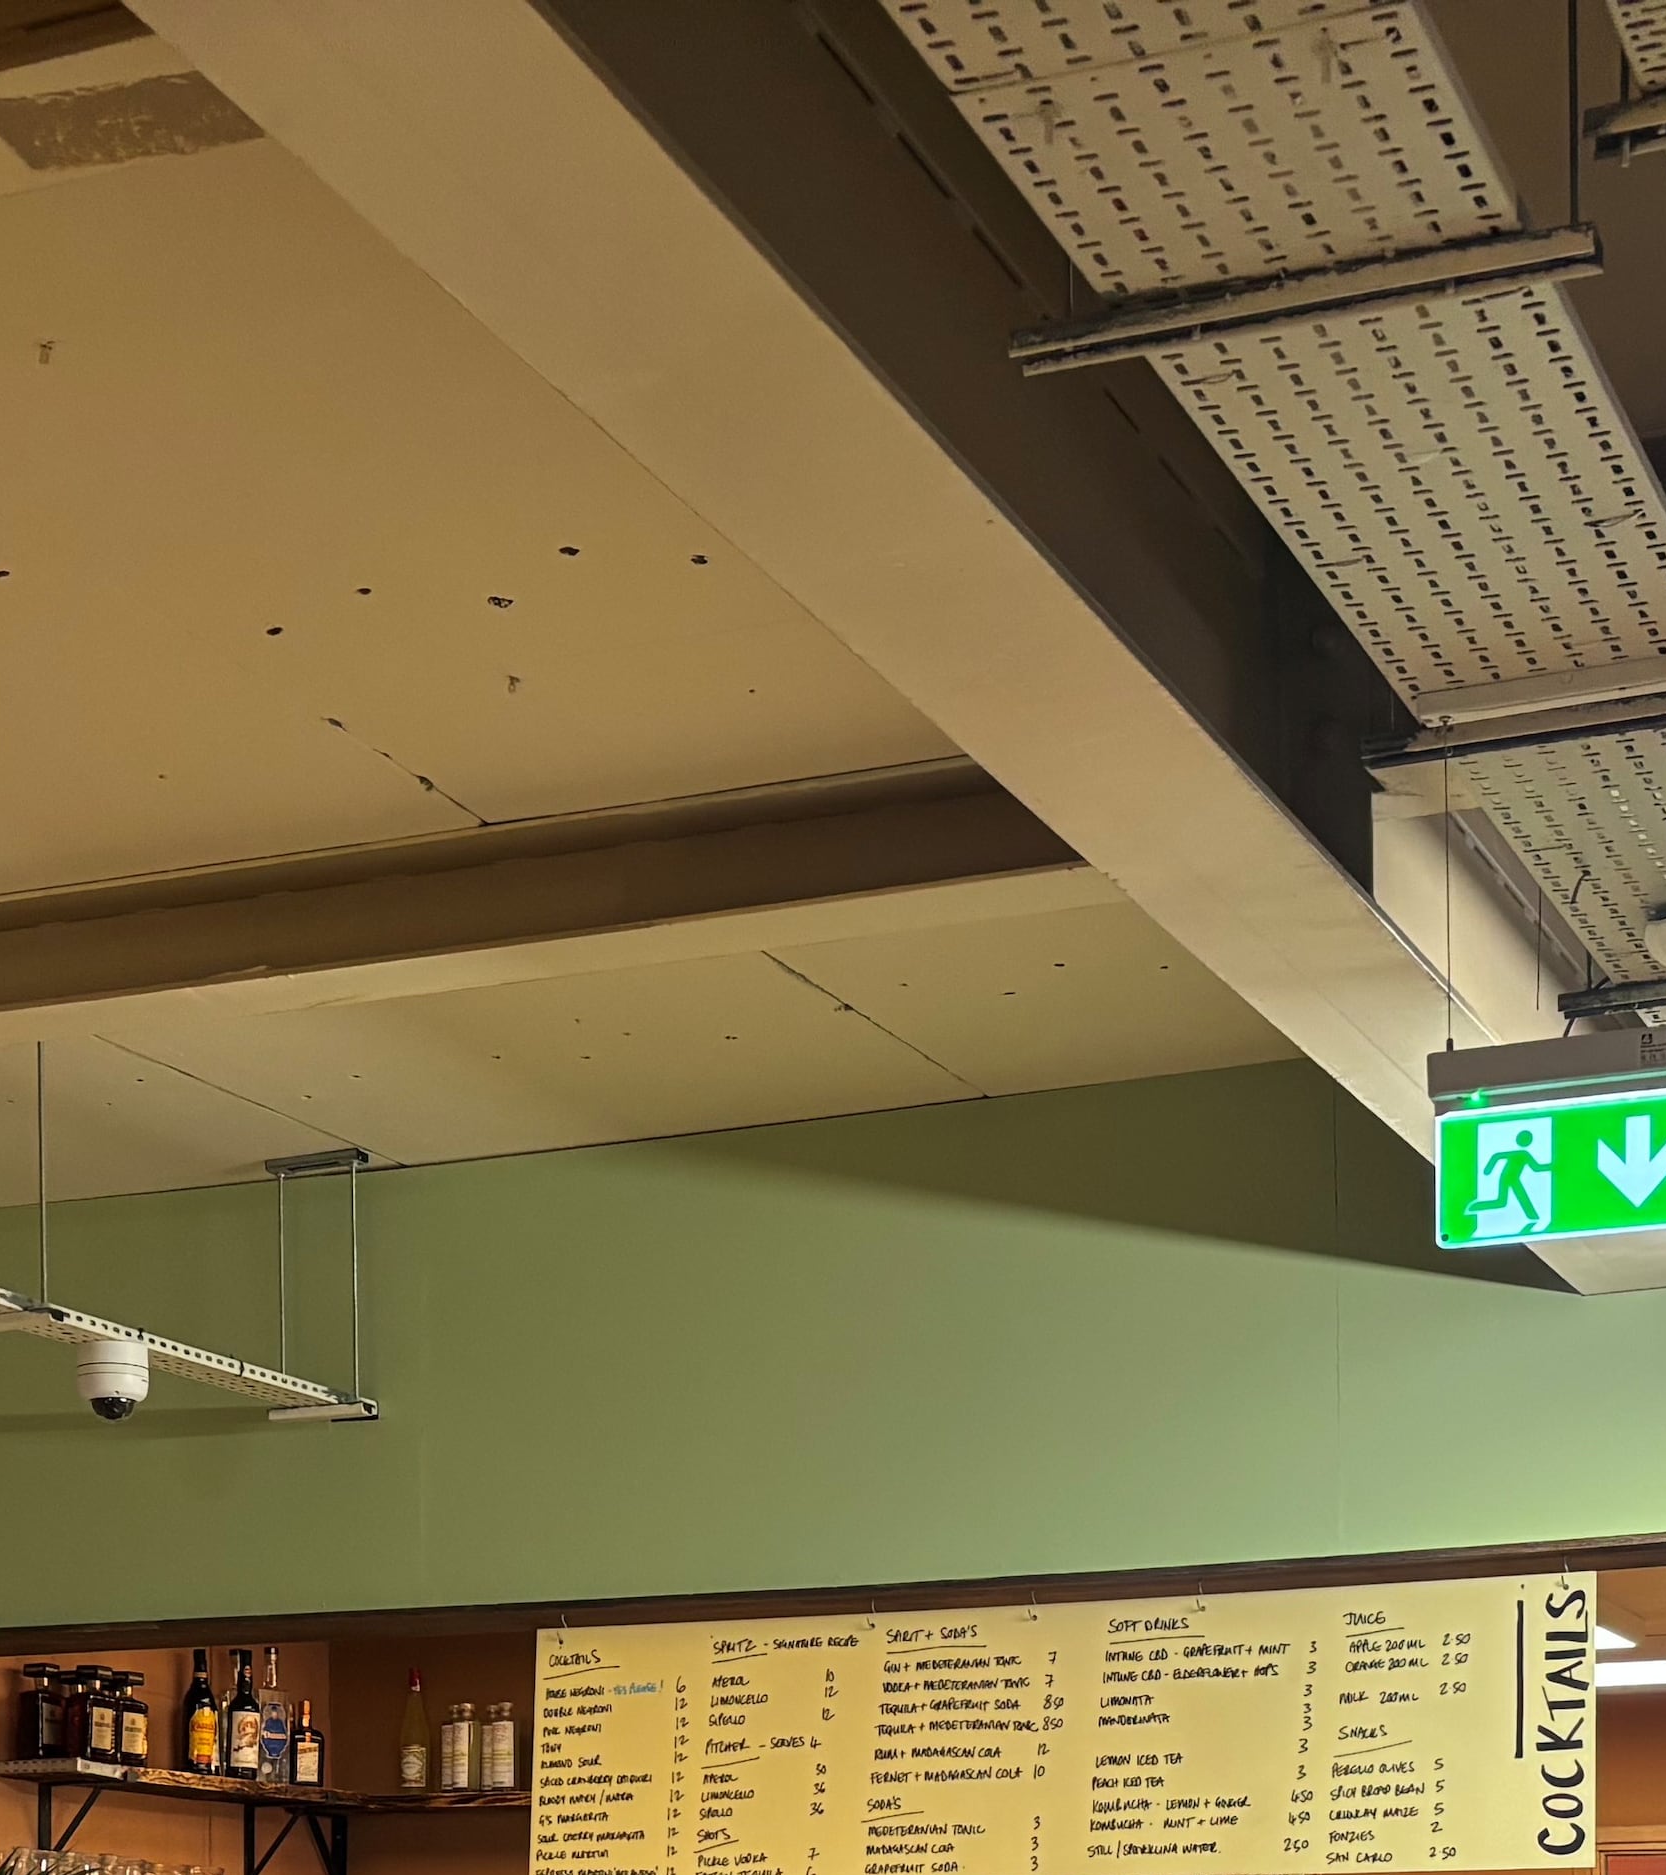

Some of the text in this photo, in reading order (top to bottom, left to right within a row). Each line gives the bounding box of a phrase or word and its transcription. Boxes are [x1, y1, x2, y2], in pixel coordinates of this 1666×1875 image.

[1107, 1617, 1189, 1633] SOFT DRINKS
[1343, 1611, 1386, 1626] JUICE
[940, 1625, 977, 1639] SODA'S
[713, 1635, 859, 1655] SPRITZ SIGNATURE RECIPE
[1149, 1648, 1168, 1661] CBD
[1259, 1643, 1291, 1656] MINT
[1309, 1641, 1317, 1653] 3
[1349, 1639, 1382, 1653] APPLE
[549, 1649, 601, 1667] COCKTAILS
[884, 1661, 900, 1673] GIN
[1048, 1651, 1057, 1664] 7
[1345, 1659, 1385, 1672] ORANGE
[712, 1668, 834, 1688] APEROL 10
[1103, 1671, 1138, 1684] INTUNE
[1141, 1669, 1161, 1681] CBD
[1254, 1663, 1279, 1676] HOPS
[1307, 1661, 1317, 1674] 3
[676, 1676, 686, 1693] 6
[1045, 1674, 1054, 1688] 7
[711, 1686, 839, 1708] LIMONCELLO 12
[930, 1697, 989, 1711] GRAPEFRUIT
[994, 1699, 1021, 1710] SODA
[1100, 1684, 1312, 1708] LIMONATA 3
[1339, 1691, 1368, 1704] MILK
[543, 1697, 688, 1718] DOUBLE NEGRONI 12
[822, 1708, 835, 1721] 12
[1304, 1703, 1311, 1713] 3
[676, 1717, 689, 1730] 12
[874, 1724, 916, 1737] TEQUILA
[1303, 1716, 1312, 1731] 3
[1536, 1590, 1589, 1855] COCKTAILS
[1338, 1725, 1387, 1740] SNACKS
[674, 1735, 689, 1749] 12
[705, 1736, 821, 1755] PITCHER SERVES 4
[911, 1746, 976, 1758] MADAGASCAN
[978, 1747, 1001, 1758] COLA
[1038, 1743, 1050, 1756] 12
[1096, 1738, 1308, 1768] LEMON ICED TEA 3
[578, 1754, 602, 1768] SOUR
[674, 1751, 688, 1764] 12
[1379, 1761, 1415, 1773] OLIVES
[1434, 1758, 1444, 1770] 5
[672, 1771, 684, 1784] 12
[871, 1764, 1045, 1784] FERNET MADAGASCAN COLA 10
[1092, 1765, 1306, 1791] PEACH ICED TEA 3
[670, 1789, 684, 1803] 12
[701, 1782, 825, 1803] LIMONCELLO 36
[1361, 1784, 1391, 1797] BROAD
[1395, 1782, 1424, 1796] BEAN
[1436, 1779, 1445, 1792] 5
[810, 1802, 824, 1816] 36
[867, 1796, 901, 1812] SODA'S
[1093, 1798, 1152, 1814] KOMBUCHA
[1166, 1797, 1200, 1810] LEMON
[1434, 1802, 1444, 1816] 5
[667, 1808, 681, 1821] 12
[952, 1824, 985, 1835] TONIC
[1034, 1816, 1040, 1830] 3
[1090, 1816, 1238, 1832] KOMBUCHA MINT LIME
[538, 1833, 558, 1844] SOUR
[668, 1827, 679, 1838] 12
[697, 1828, 730, 1843] SHOTS
[1329, 1822, 1443, 1844] FONZIES 2
[536, 1849, 566, 1861] PICKLE
[667, 1845, 677, 1857] 12
[866, 1836, 1039, 1856] MADAGASCAN COLA 3
[698, 1848, 820, 1867] PICKLE VODKA 7
[865, 1856, 1038, 1874] GRAPEFRUIT SODA 3
[1326, 1852, 1349, 1864] SAN
[1356, 1852, 1392, 1863] CARLO
